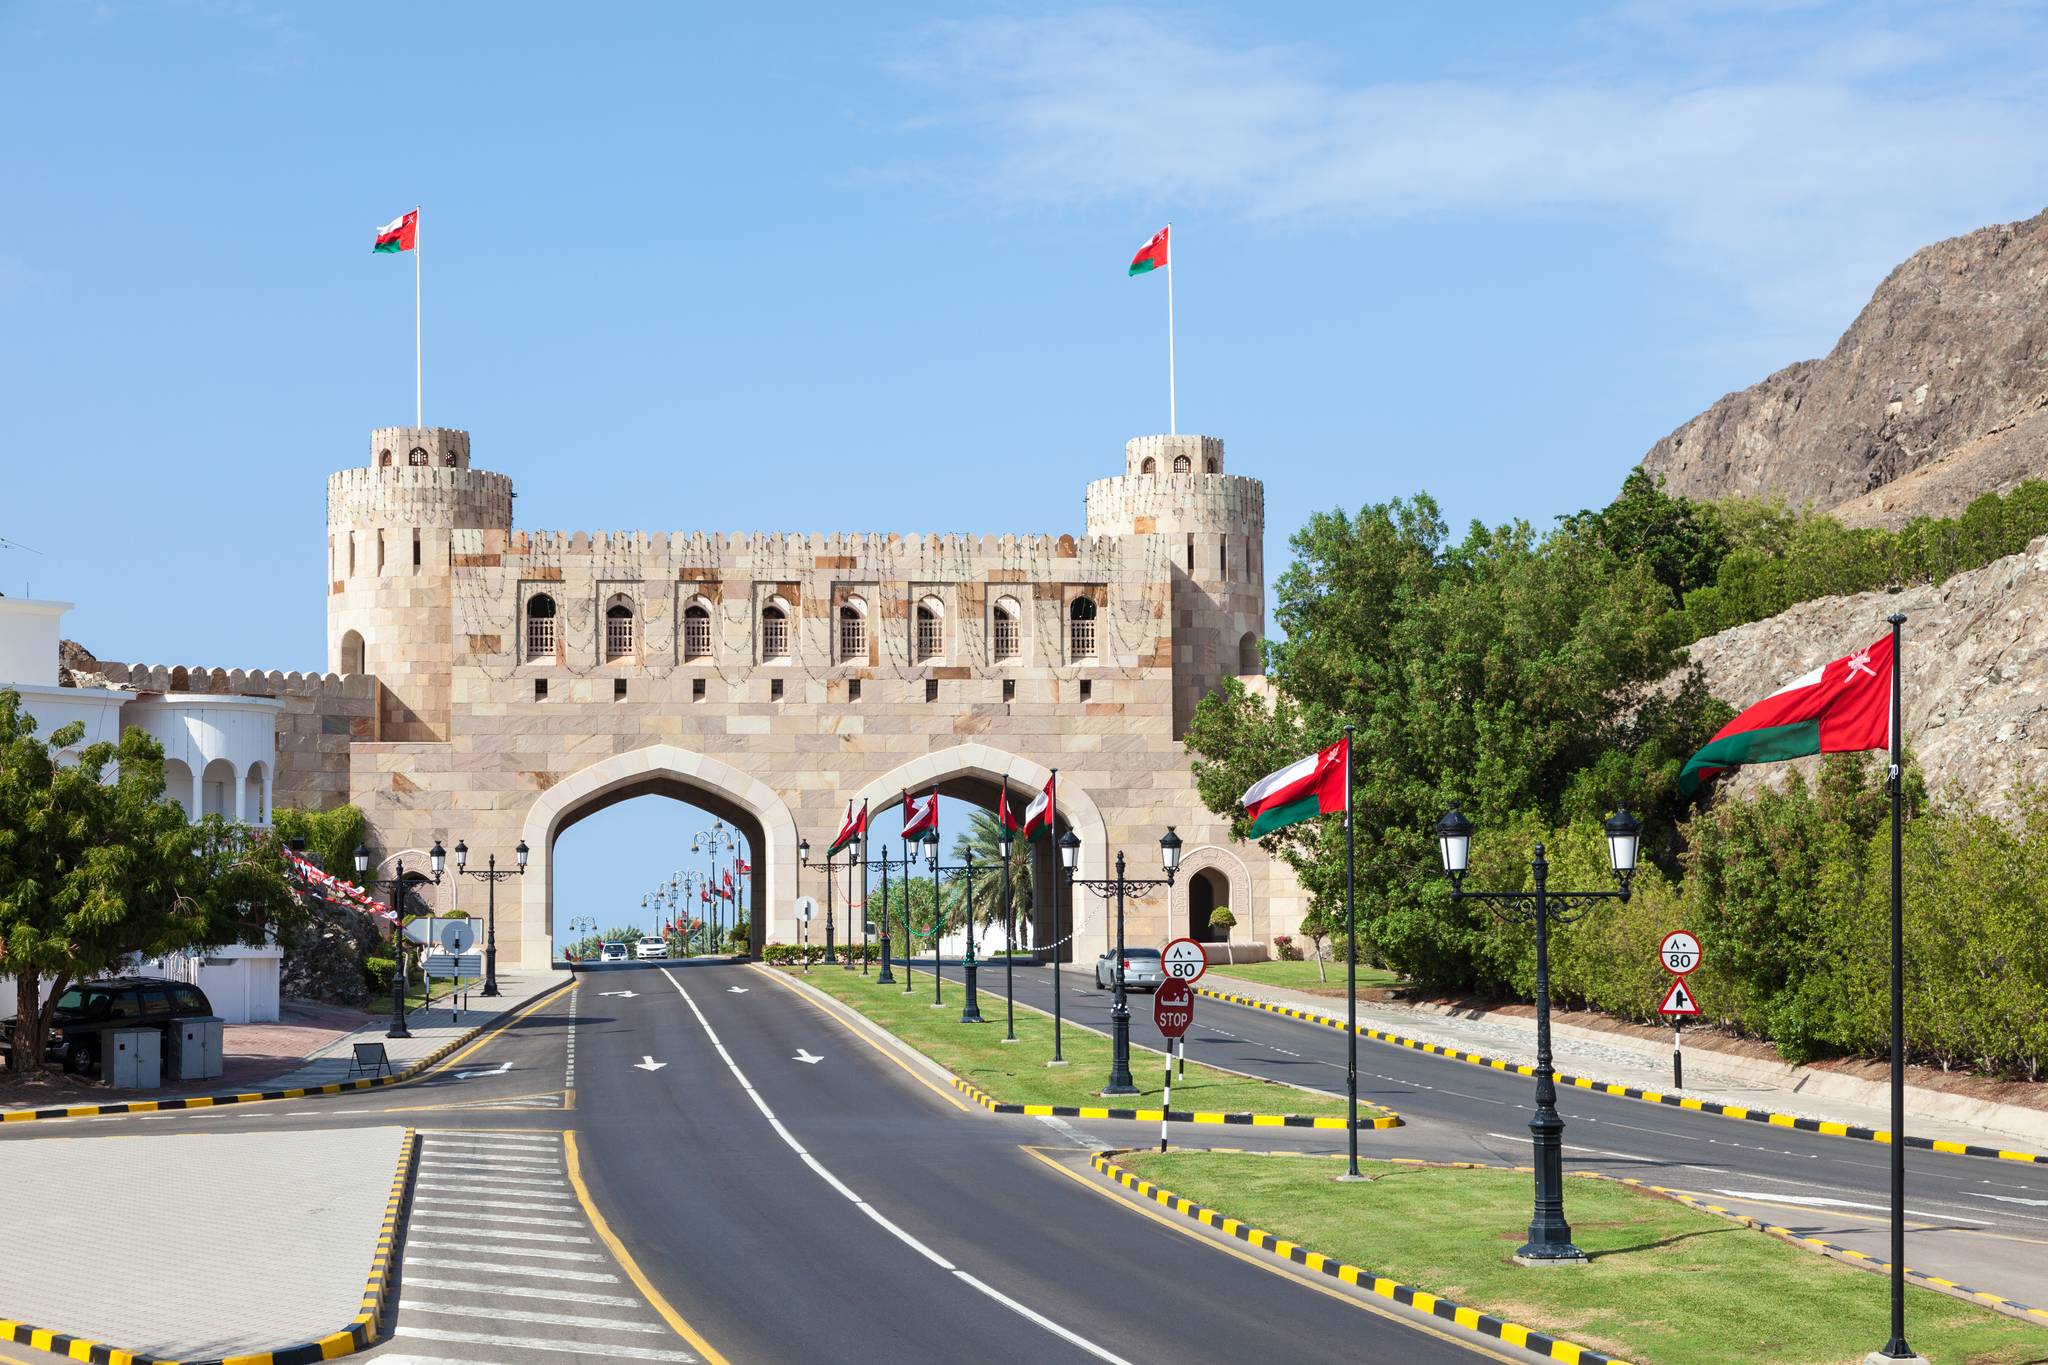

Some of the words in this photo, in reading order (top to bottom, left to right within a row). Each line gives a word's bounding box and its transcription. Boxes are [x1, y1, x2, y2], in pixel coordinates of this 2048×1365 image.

[1670, 954, 1691, 968] 80
[1172, 963, 1195, 977] 80
[1161, 987, 1189, 1007] قف
[1159, 1012, 1188, 1027] STOP
